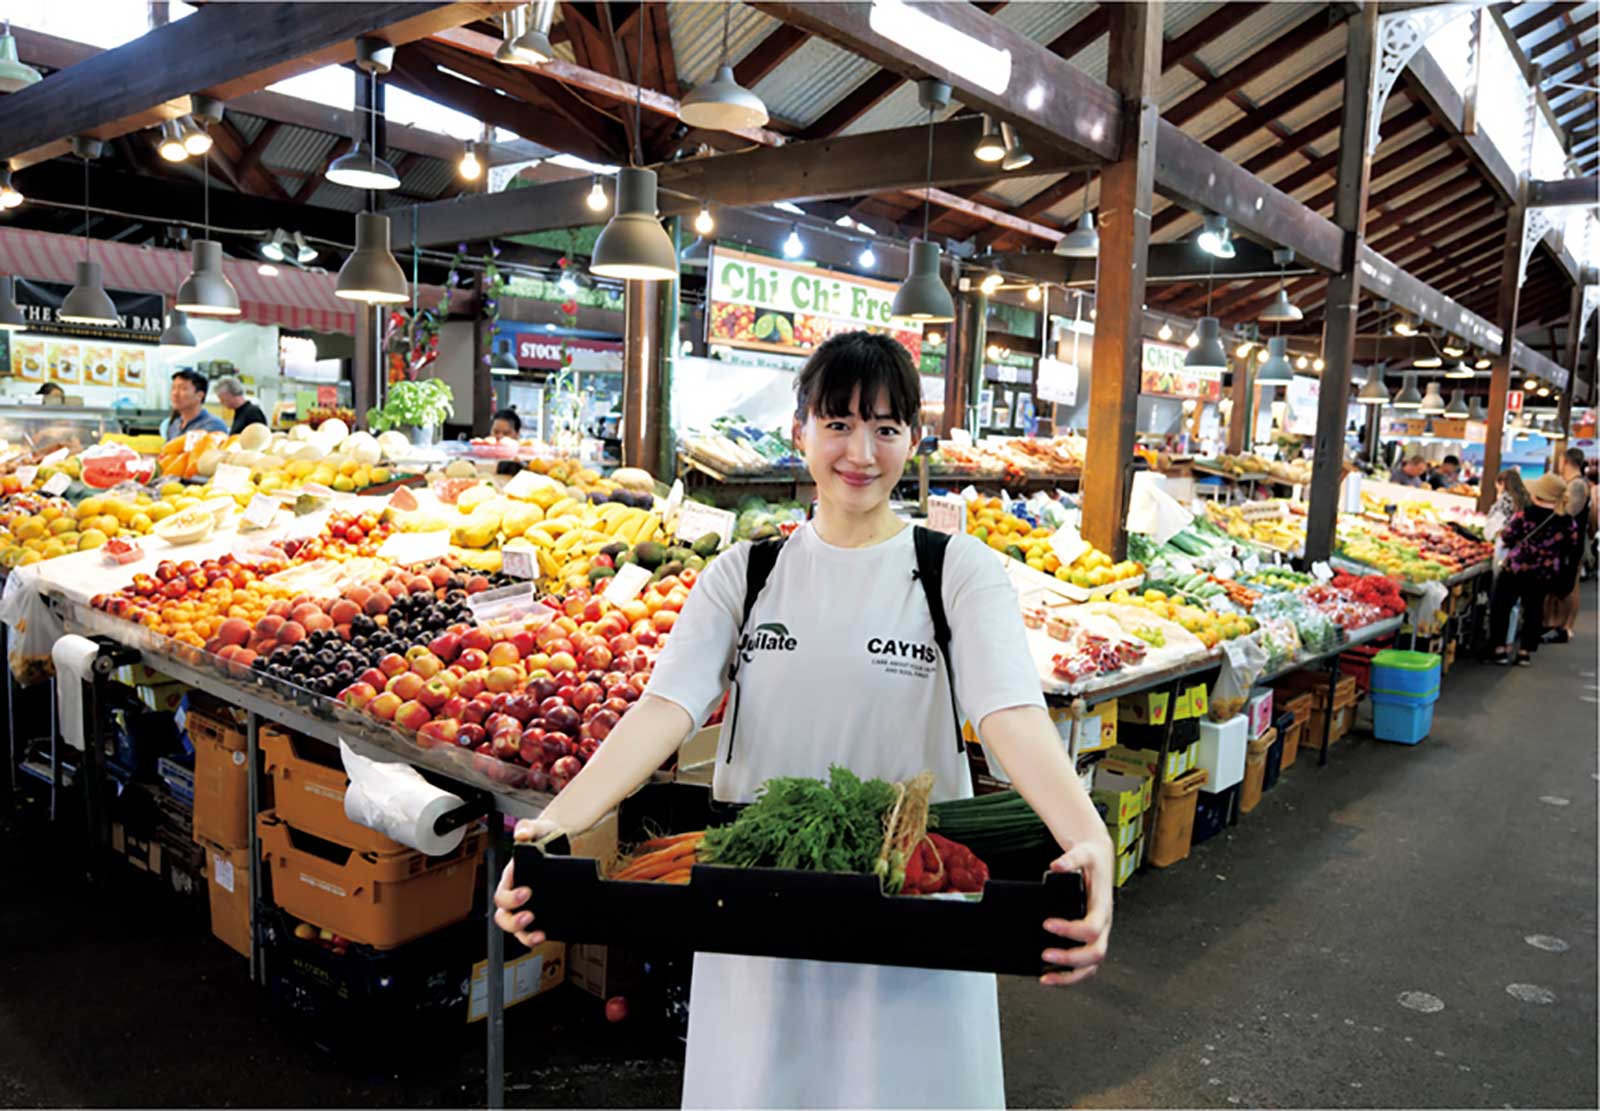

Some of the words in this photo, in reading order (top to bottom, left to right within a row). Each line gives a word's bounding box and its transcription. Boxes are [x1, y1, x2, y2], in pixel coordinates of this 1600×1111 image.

[721, 262, 778, 303] Chi
[791, 276, 841, 313] Chi
[20, 305, 51, 321] THE
[133, 316, 161, 331] BAR
